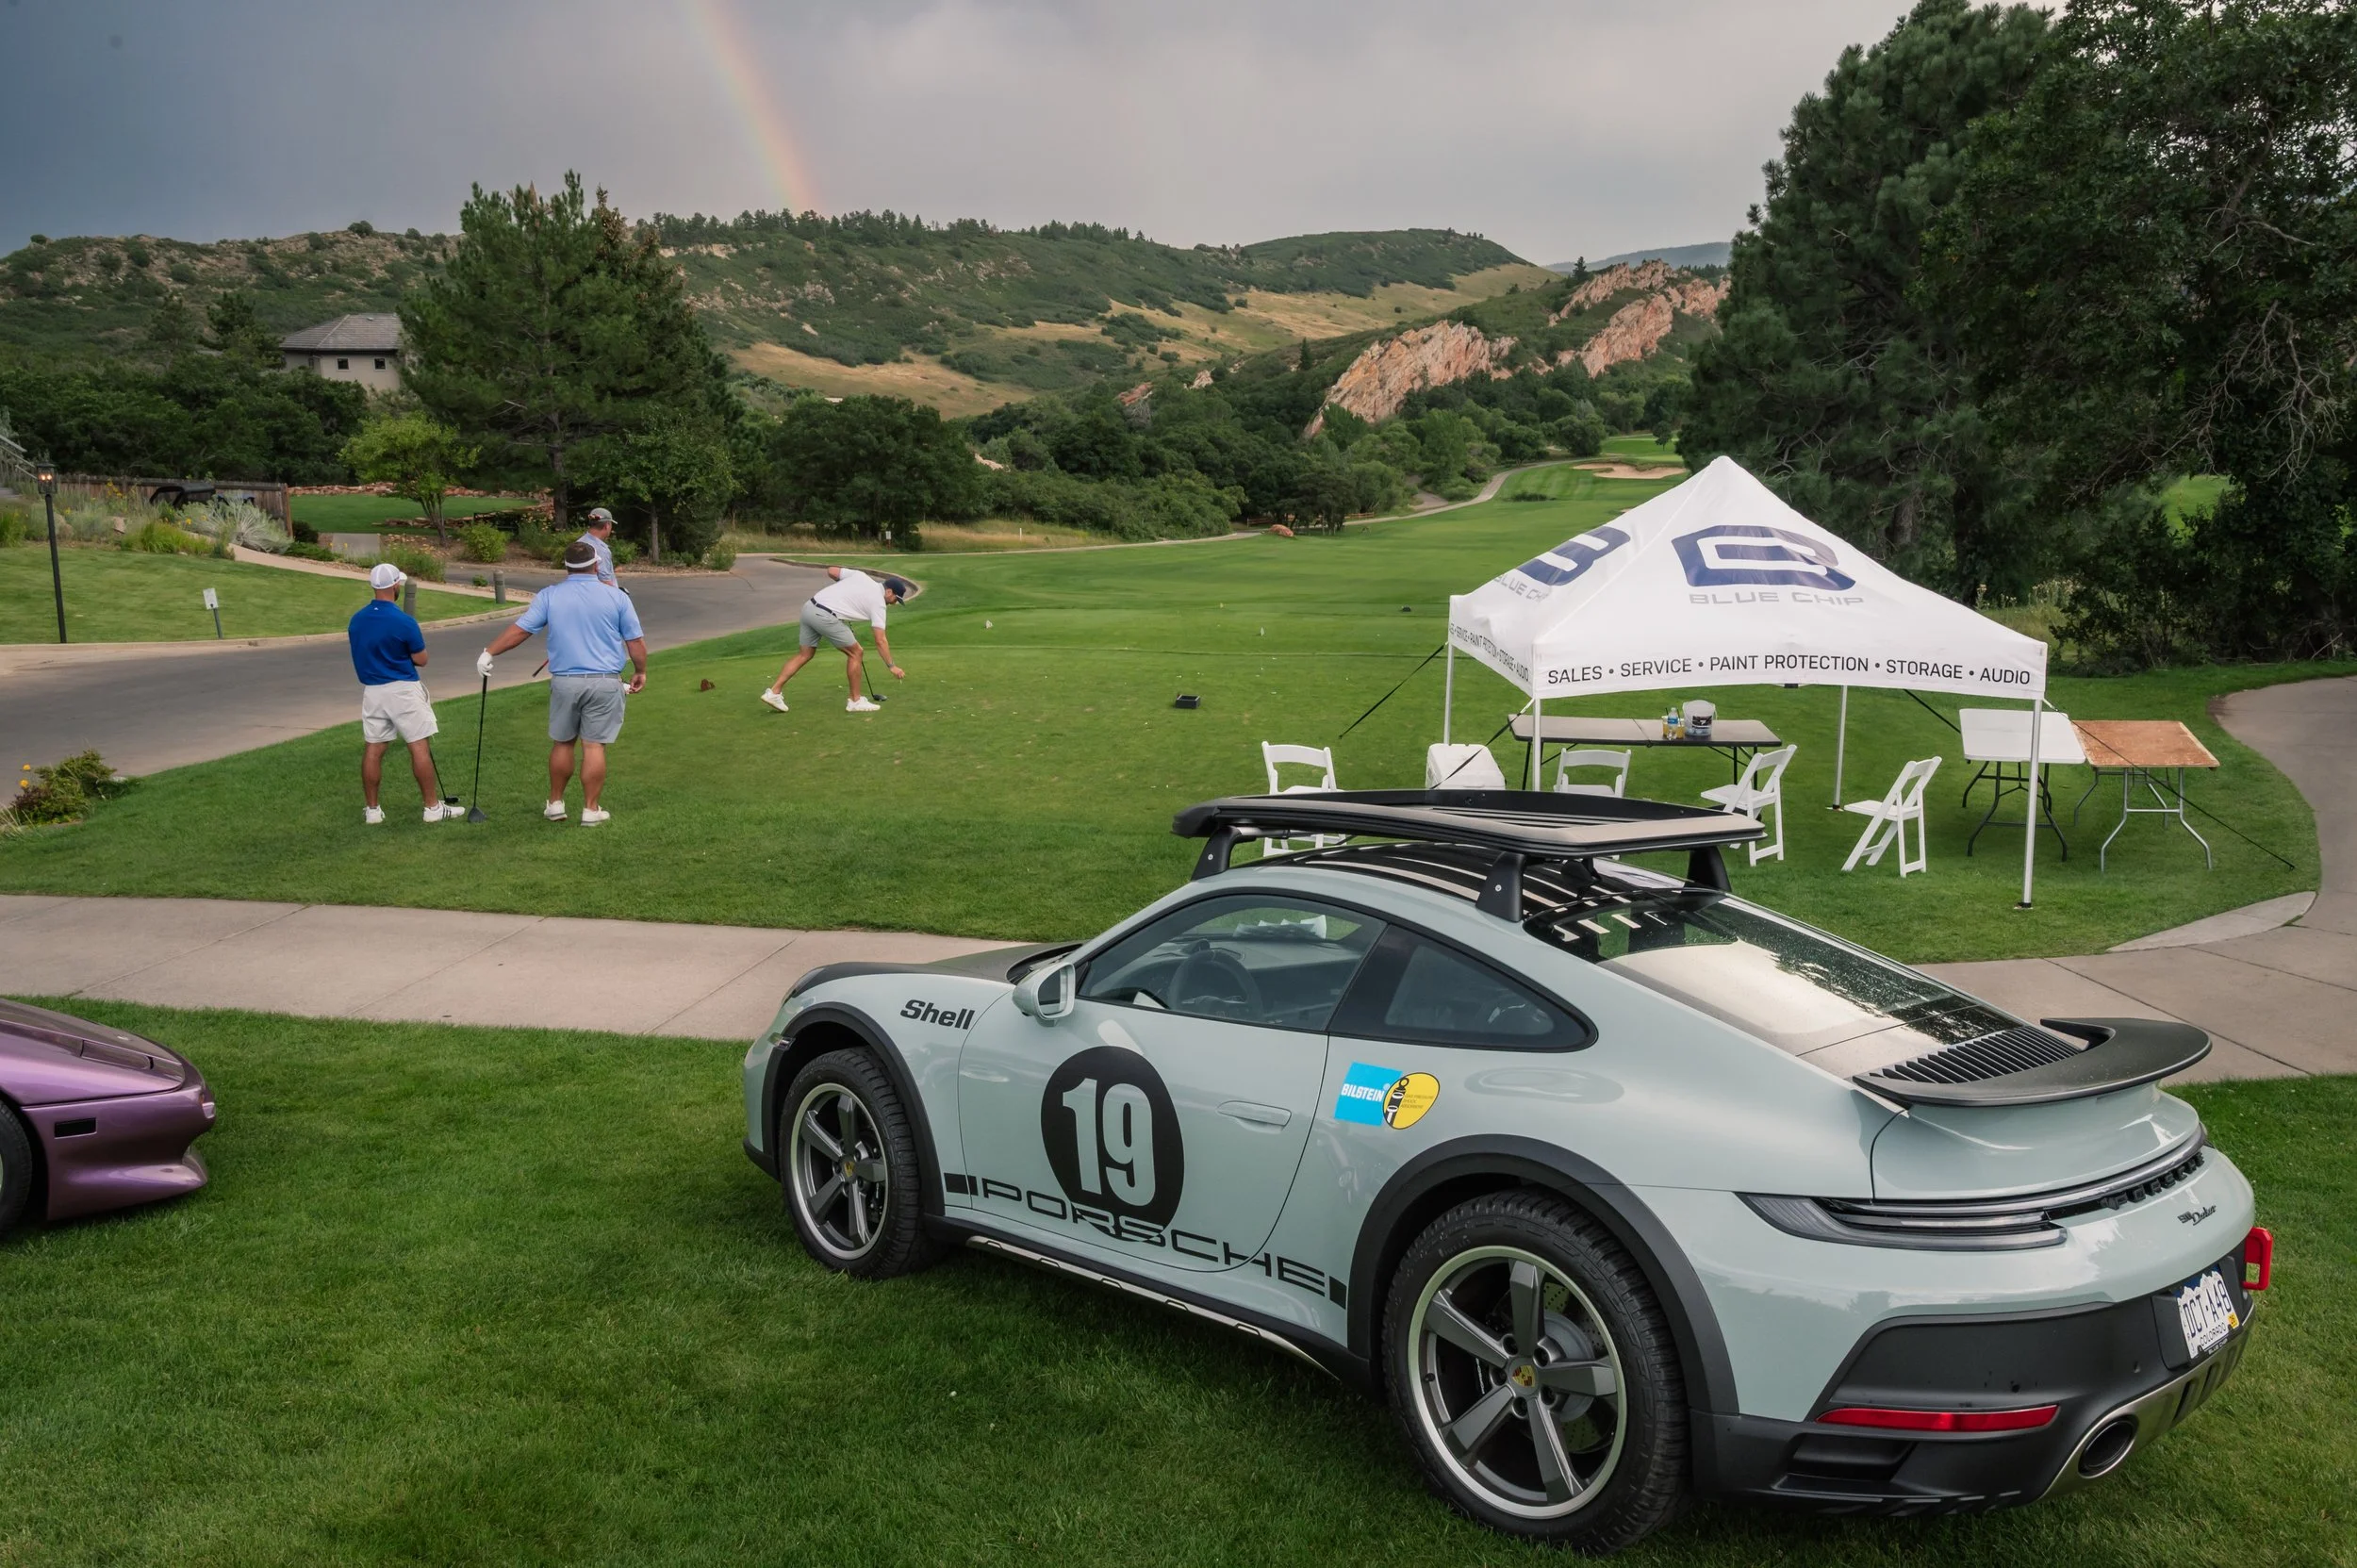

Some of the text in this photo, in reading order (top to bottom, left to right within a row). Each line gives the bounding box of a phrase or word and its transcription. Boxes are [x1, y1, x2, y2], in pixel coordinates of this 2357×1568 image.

[1689, 591, 1865, 606] BLUE CHIP
[1548, 654, 2031, 685] SALES SERVICE PAINT PROTECTION STORAGE AUDIO
[899, 999, 976, 1030] Shell
[1341, 1082, 1385, 1102] BILSTEIN
[1062, 1078, 1156, 1207] 19
[981, 1178, 1326, 1297] PORSCHE
[2200, 1322, 2226, 1347] COLORADO
